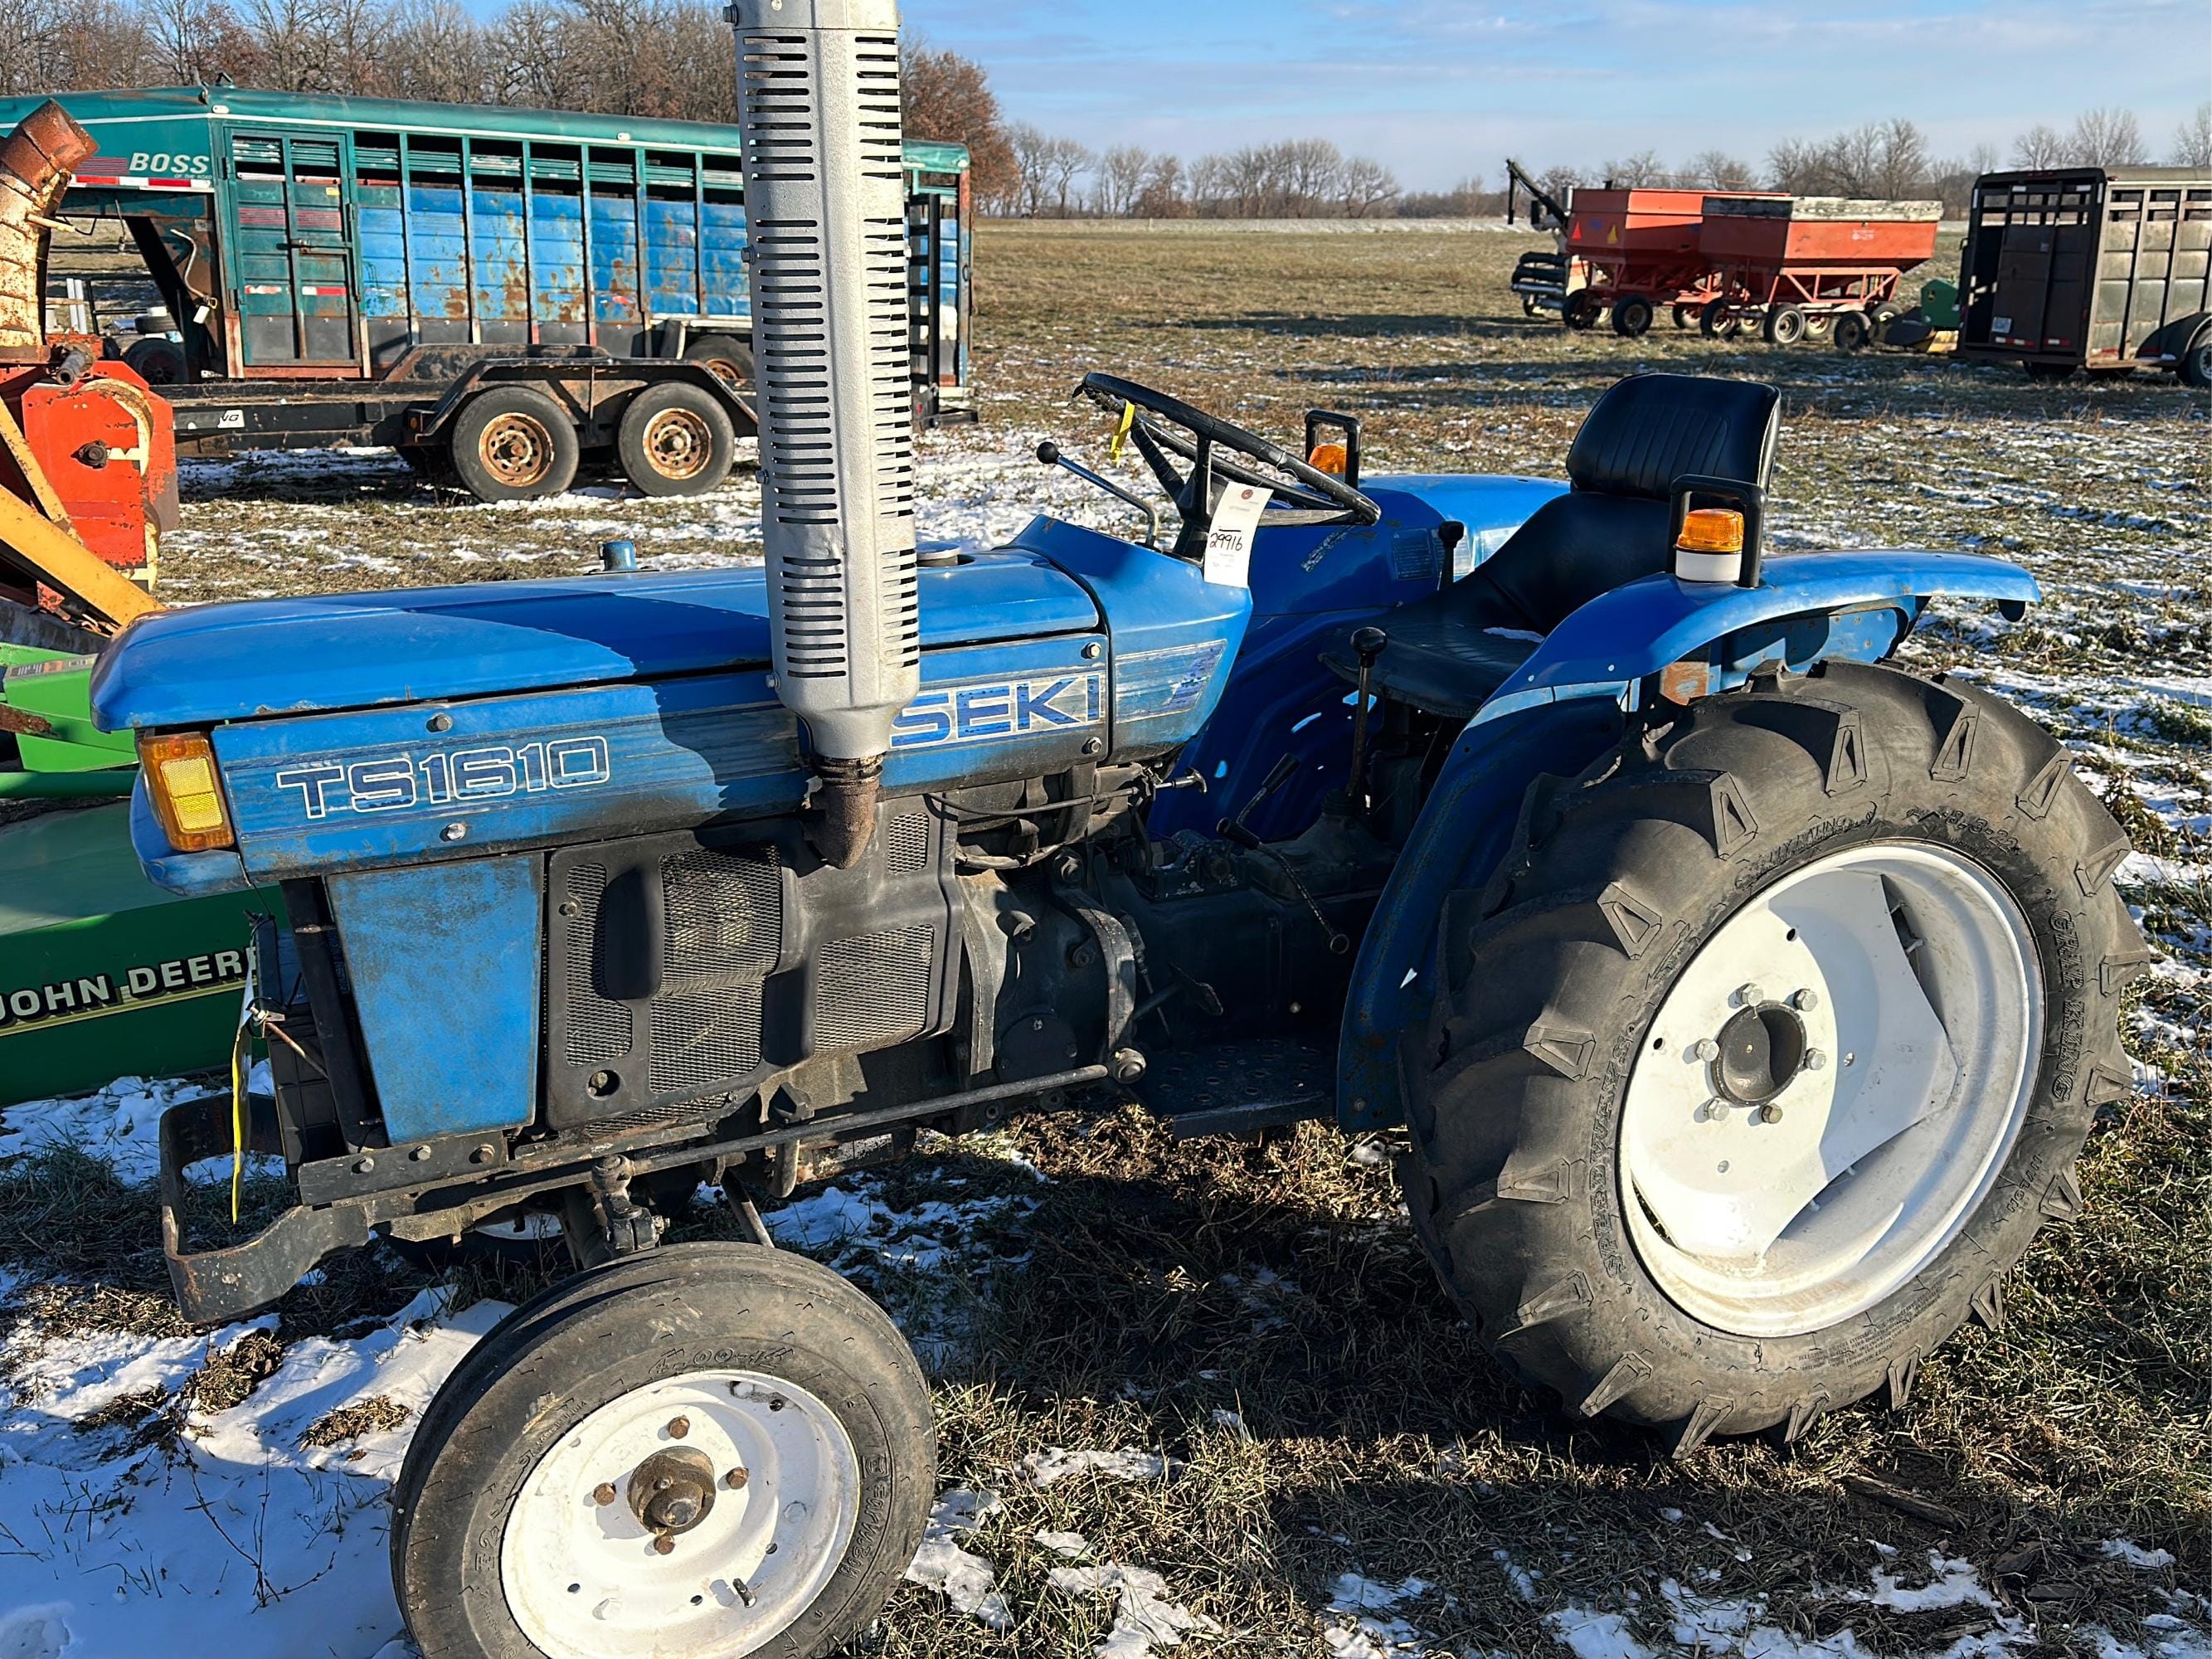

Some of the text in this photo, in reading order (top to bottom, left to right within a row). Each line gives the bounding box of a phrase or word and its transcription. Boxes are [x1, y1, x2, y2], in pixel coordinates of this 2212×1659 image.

[129, 153, 210, 174] BOSS
[1209, 533, 1243, 552] 29916
[276, 735, 610, 820] TS1610
[2049, 909, 2085, 1102] GRIP KING
[1589, 1036, 1634, 1279] SPEEDWAYS
